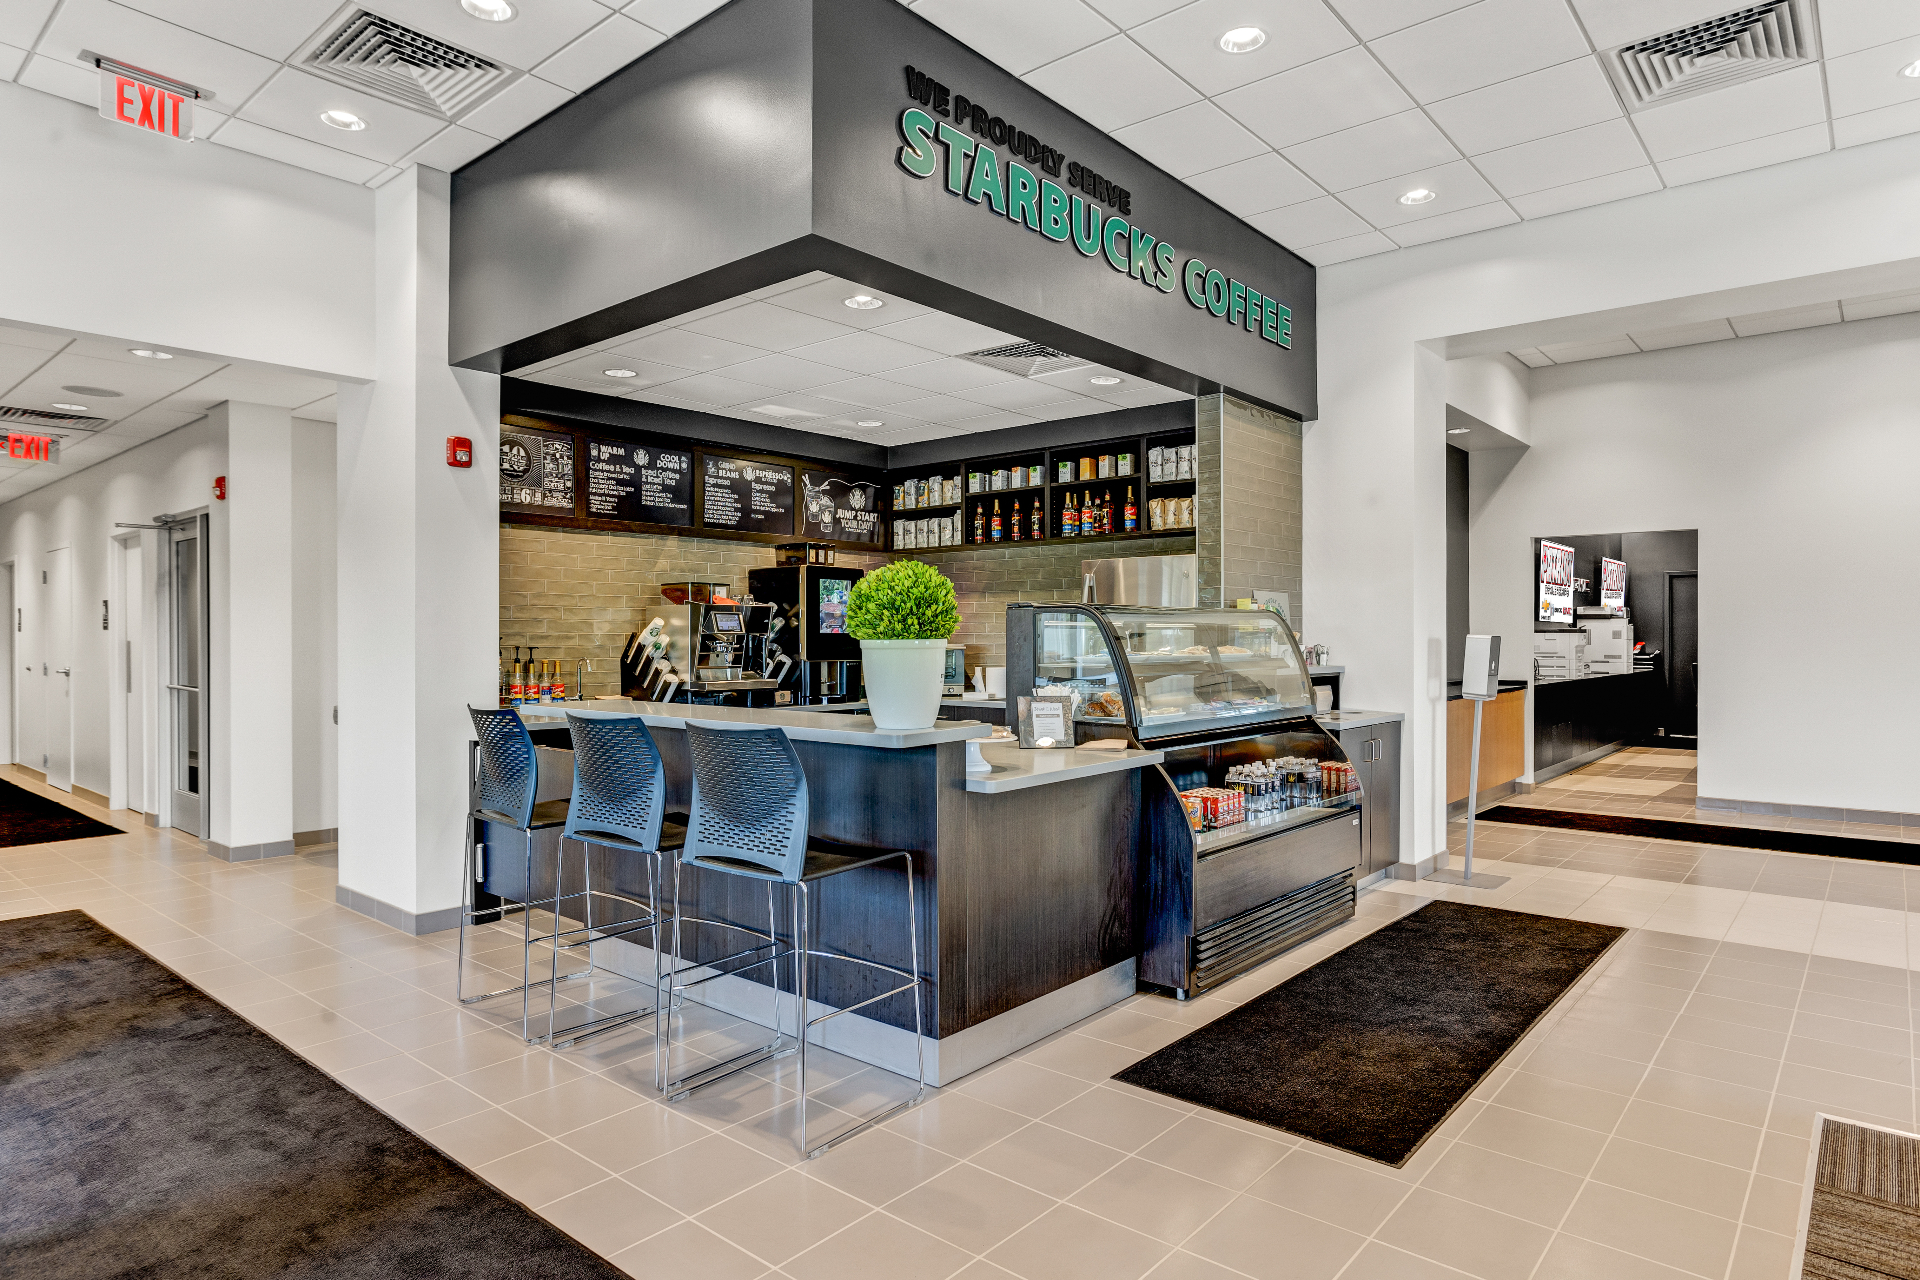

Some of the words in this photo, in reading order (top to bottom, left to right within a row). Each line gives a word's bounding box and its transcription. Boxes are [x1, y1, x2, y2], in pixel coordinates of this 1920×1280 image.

[115, 76, 184, 137] EXIT
[905, 64, 950, 117] WE
[954, 94, 1067, 178] PROUDLY
[1068, 161, 1131, 216] SERVE
[897, 107, 1176, 293] STARBUCKS
[1183, 258, 1292, 350] COFFEE
[8, 433, 52, 461] EXIT
[600, 444, 625, 456] WARM
[600, 452, 610, 460] UP
[660, 453, 680, 463] COOL
[590, 461, 615, 471] Coffee
[622, 465, 635, 474] Tea
[656, 460, 680, 470] DOWN
[642, 467, 656, 476] Iced
[657, 469, 680, 480] Coffee
[718, 469, 740, 479] BEANS
[647, 475, 663, 484] Iced
[664, 477, 676, 486] Tea
[835, 508, 856, 520] JUMP
[857, 511, 878, 522] START
[840, 519, 858, 529] YOUR
